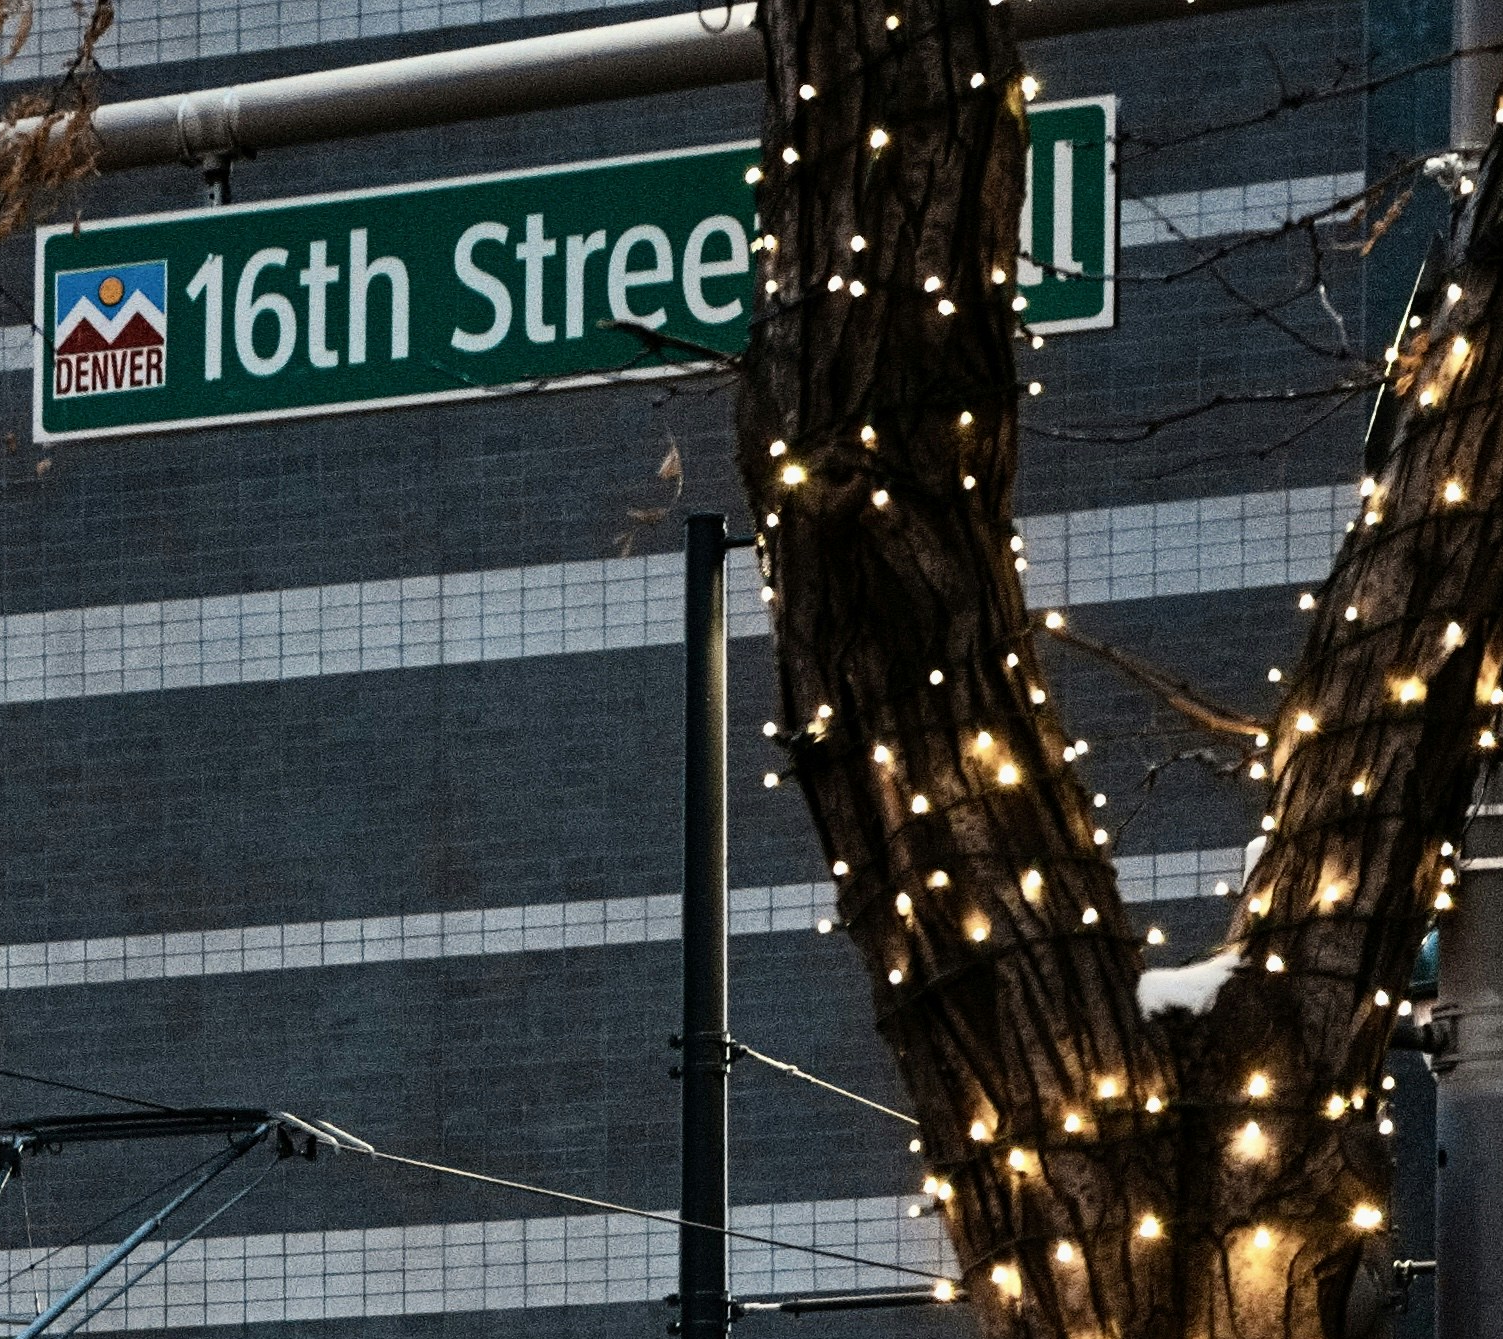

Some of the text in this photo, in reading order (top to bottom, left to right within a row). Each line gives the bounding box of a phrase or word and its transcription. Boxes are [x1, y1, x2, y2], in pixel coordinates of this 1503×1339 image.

[186, 226, 410, 382] 16th
[452, 210, 760, 355] Stree
[56, 348, 164, 396] DENVER
